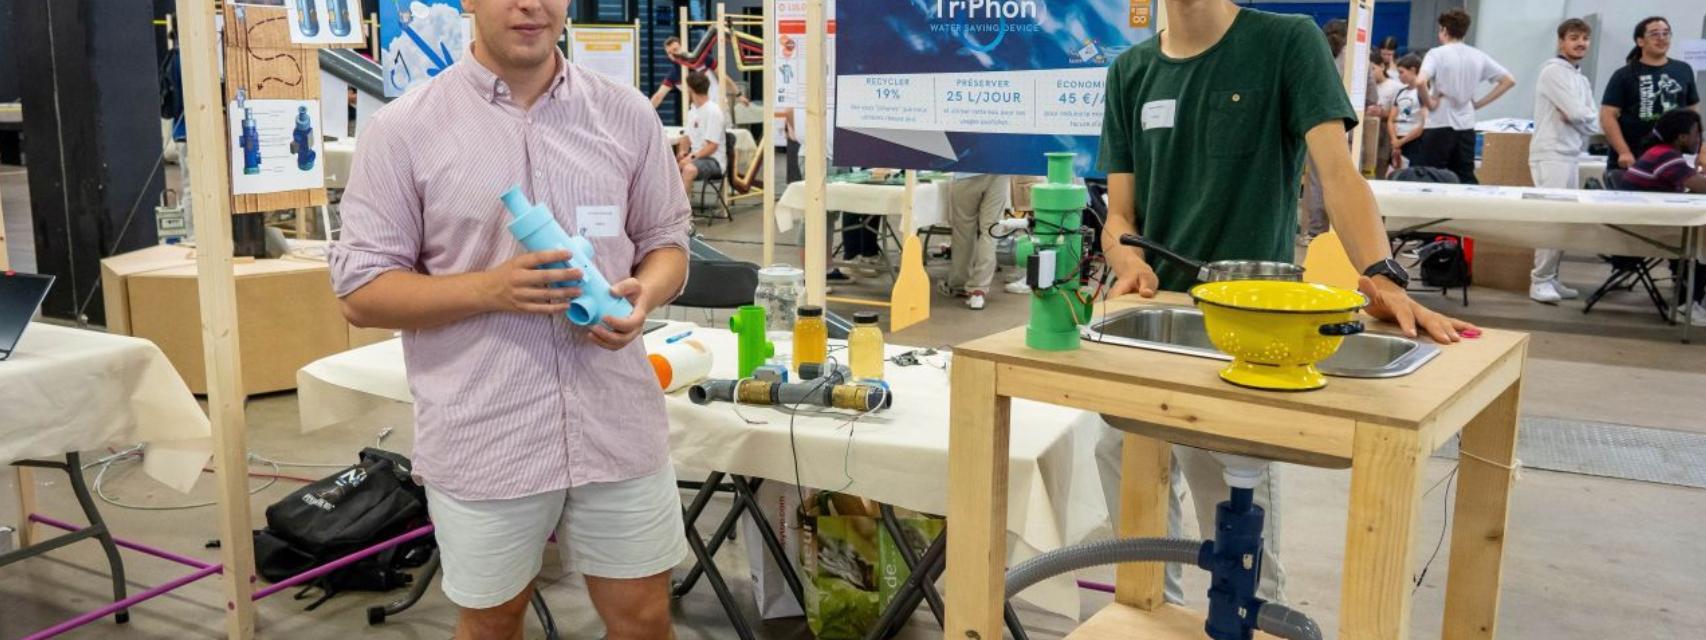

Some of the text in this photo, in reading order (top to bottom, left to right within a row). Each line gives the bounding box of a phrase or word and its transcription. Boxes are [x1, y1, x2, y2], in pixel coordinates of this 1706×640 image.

[930, 24, 1040, 32] WATER SAVING DEVICE
[866, 77, 910, 86] RECYCLER
[876, 88, 900, 99] 19%
[946, 91, 1022, 104] 25 L/JOUR
[1058, 92, 1077, 105] 45
